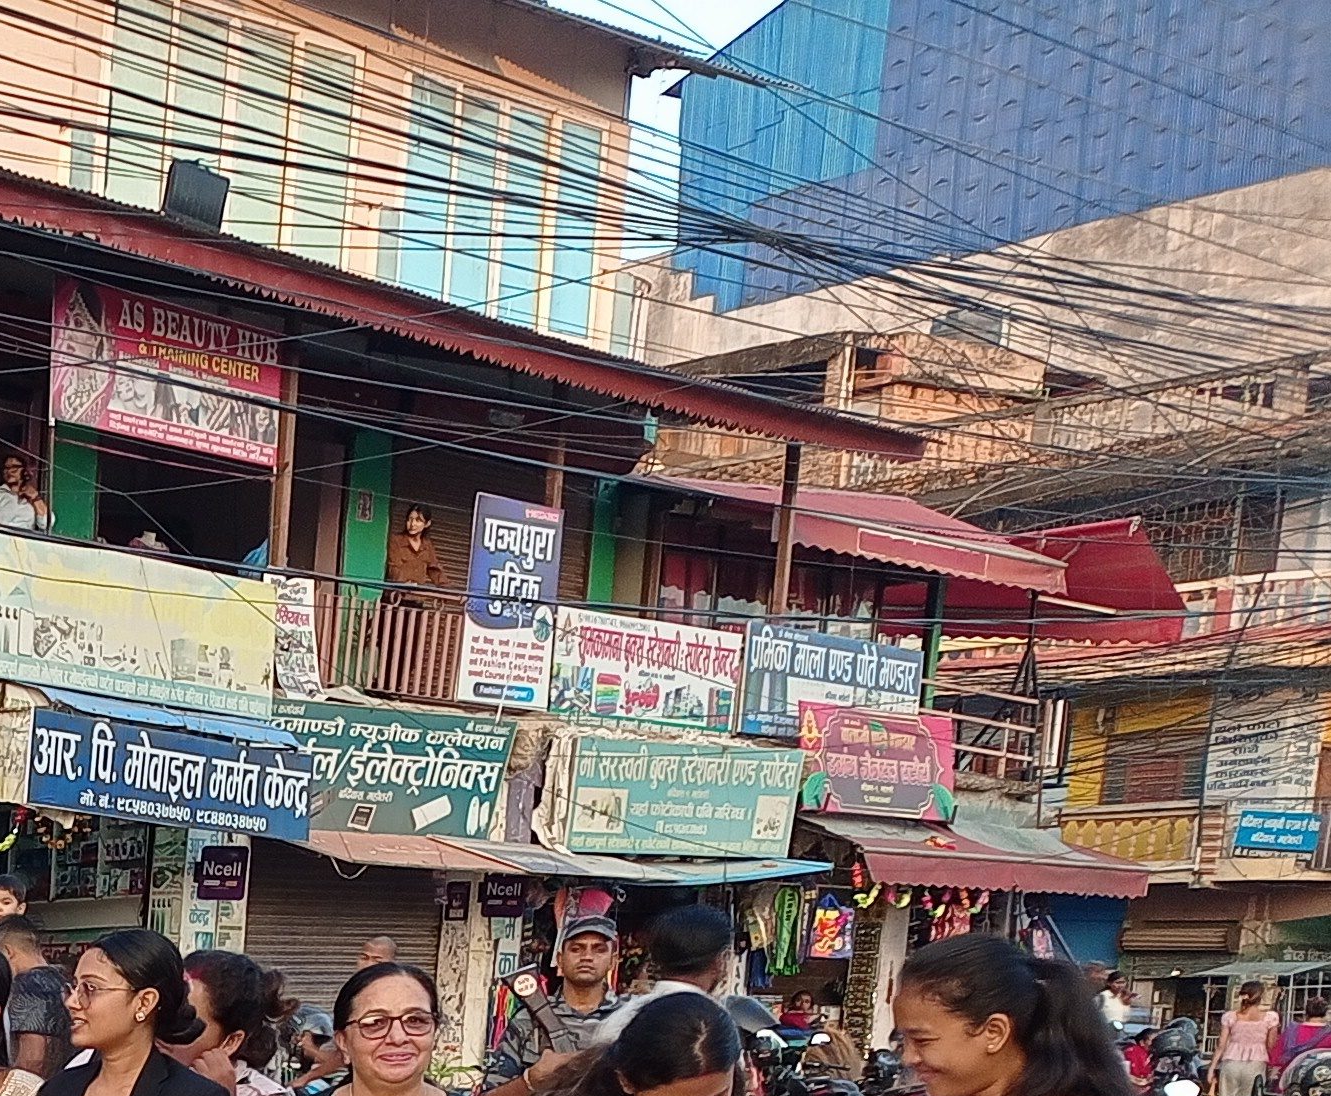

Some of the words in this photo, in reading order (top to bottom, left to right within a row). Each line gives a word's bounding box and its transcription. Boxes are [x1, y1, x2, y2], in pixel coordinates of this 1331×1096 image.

[118, 298, 145, 333] AS
[151, 306, 232, 353] BEAUTY
[236, 327, 279, 365] HUB
[211, 354, 260, 383] CENTER
[794, 642, 827, 679] माला
[263, 753, 312, 819] केन्द्र
[202, 858, 242, 878] Ncell
[487, 880, 522, 897] Ncell
